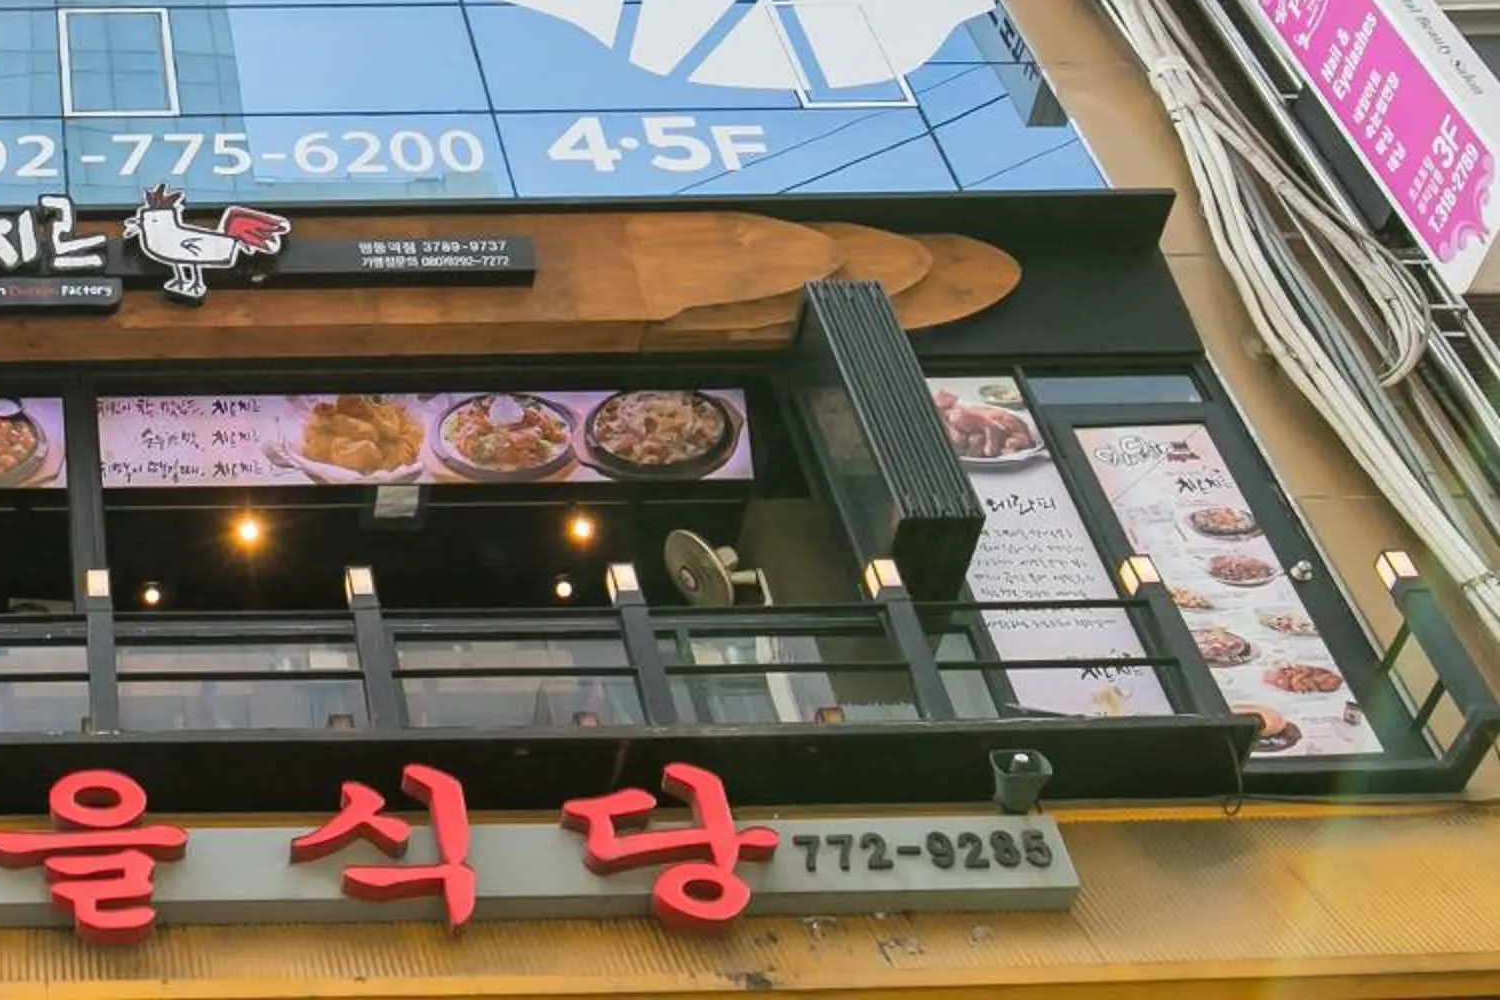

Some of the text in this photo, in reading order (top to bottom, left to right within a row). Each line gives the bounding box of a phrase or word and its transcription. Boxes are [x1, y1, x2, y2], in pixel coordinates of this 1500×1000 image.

[1320, 43, 1343, 85] Nail
[1332, 11, 1377, 101] Eyelashes
[1432, 113, 1460, 169] 3F
[61, 285, 113, 298] Factory
[792, 828, 1053, 873] 772-9285
